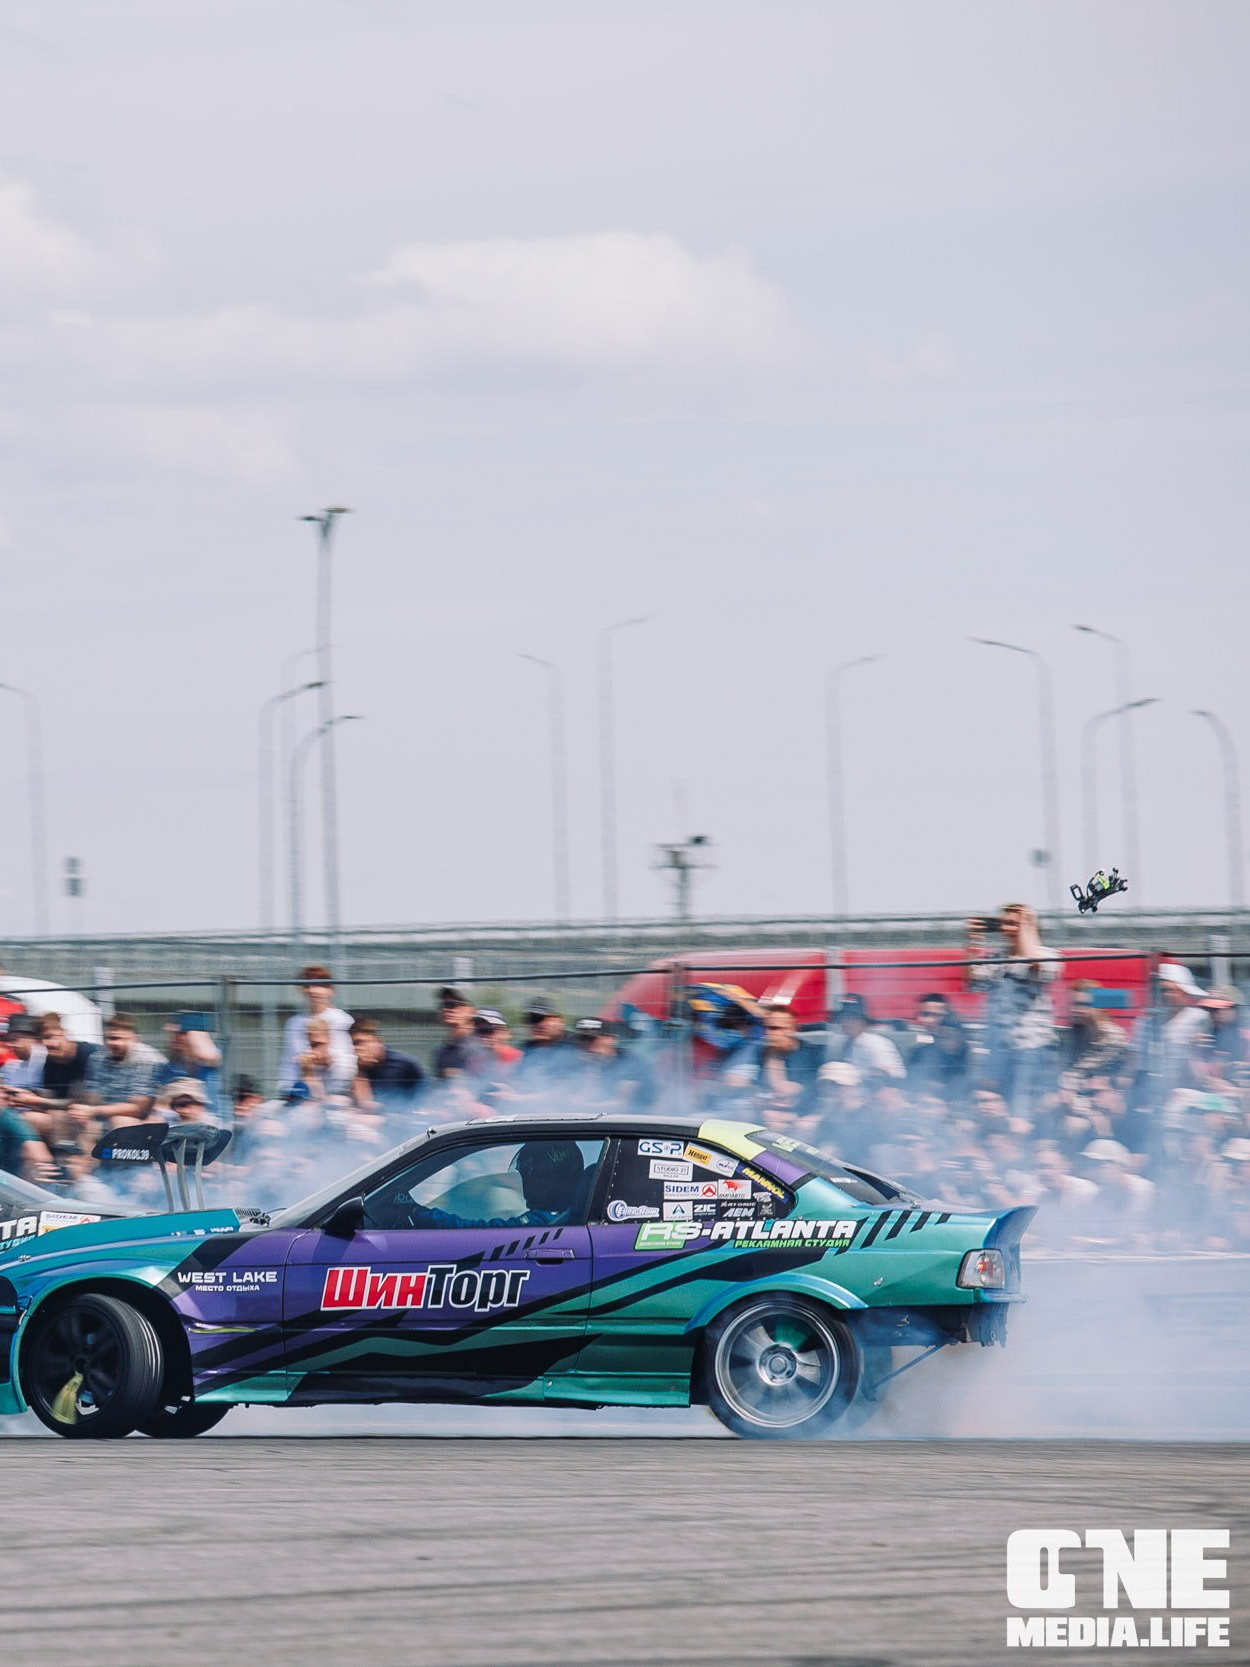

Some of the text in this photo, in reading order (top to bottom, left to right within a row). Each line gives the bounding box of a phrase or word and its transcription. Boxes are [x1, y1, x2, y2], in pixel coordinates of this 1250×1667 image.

[741, 1166, 786, 1200] MANNOL
[665, 1185, 699, 1193] SIDEM
[693, 1204, 717, 1213] ZIC
[721, 1207, 756, 1218] AEM
[639, 1220, 858, 1240] RS-ATLANTA
[733, 1238, 850, 1249] РЕКЛАМНАЯ СТУДИЯ
[177, 1270, 278, 1284] WEST LAKE
[195, 1284, 260, 1293] МЕСТО ОТДЫХА
[320, 1264, 531, 1312] ШинТорг
